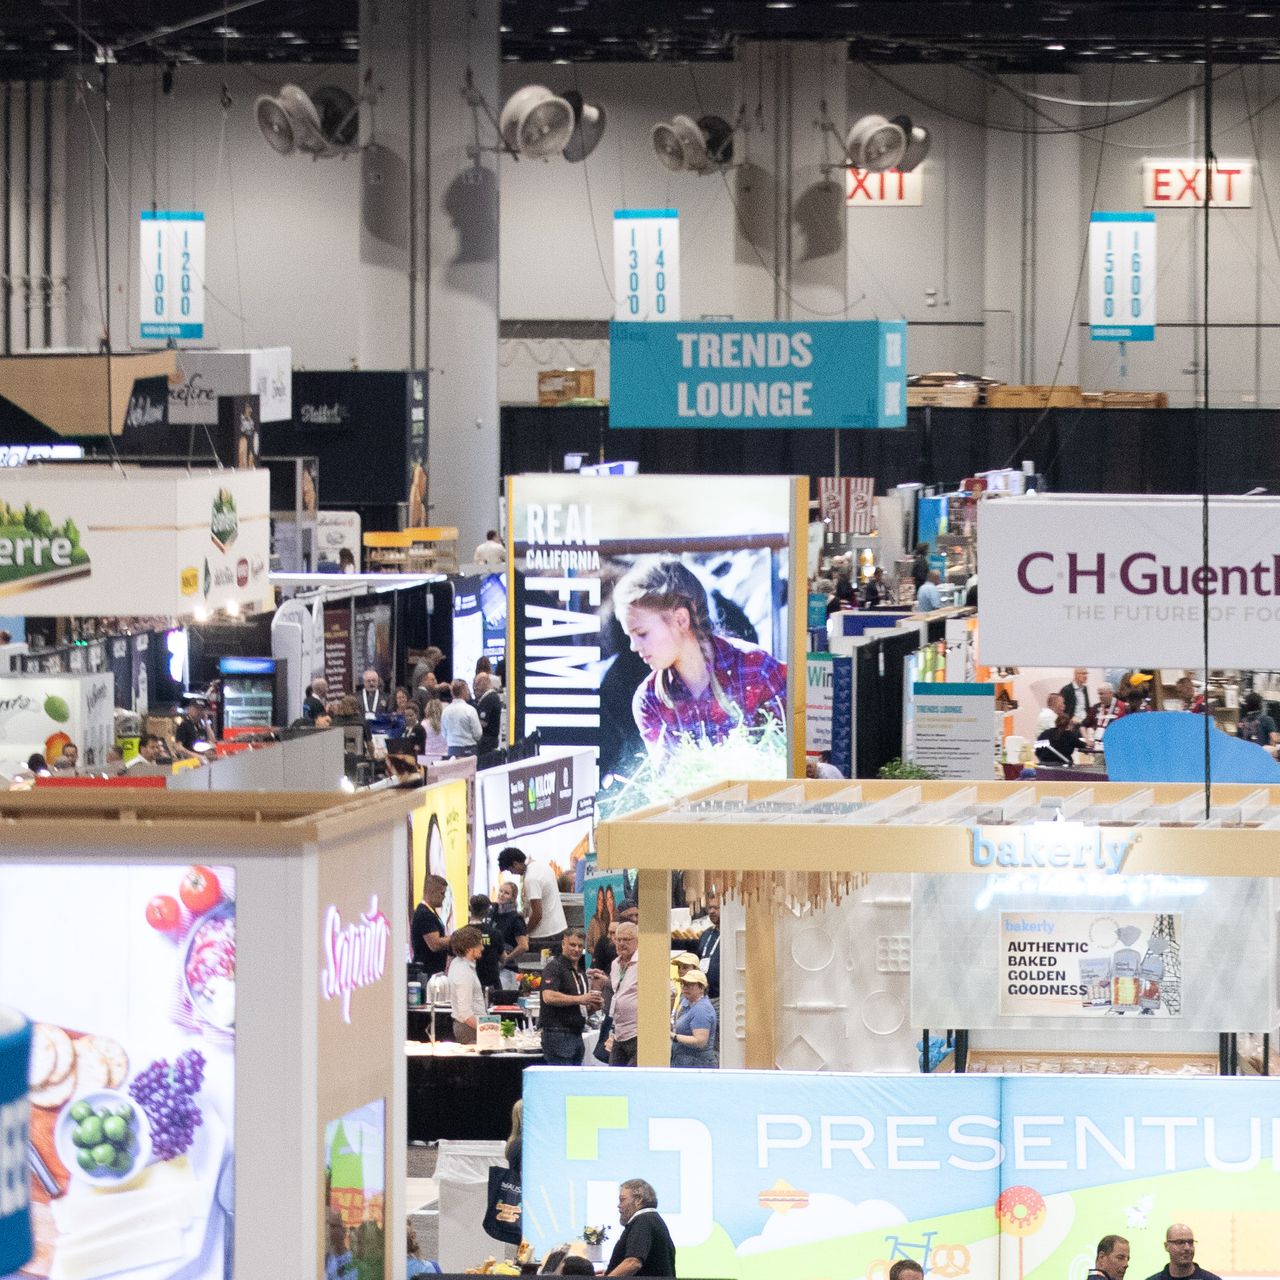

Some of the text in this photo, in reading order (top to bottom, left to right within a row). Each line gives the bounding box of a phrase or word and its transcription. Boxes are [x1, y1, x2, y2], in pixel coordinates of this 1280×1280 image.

[847, 168, 905, 200] XIT
[676, 333, 813, 368] TRENDS
[677, 382, 813, 417] LOUNGE
[526, 504, 601, 544] REAL
[526, 547, 601, 569] CALIFORNIA
[1064, 605, 1107, 622] THE
[1113, 604, 1199, 622] FUTURE
[970, 826, 1130, 875] bakerly
[1004, 918, 1055, 935] bakerly
[1008, 941, 1089, 953] AUTHENTIC
[1008, 956, 1057, 967] BAKED
[1008, 970, 1066, 981] GOLDEN
[1008, 984, 1088, 996] GOODNESS
